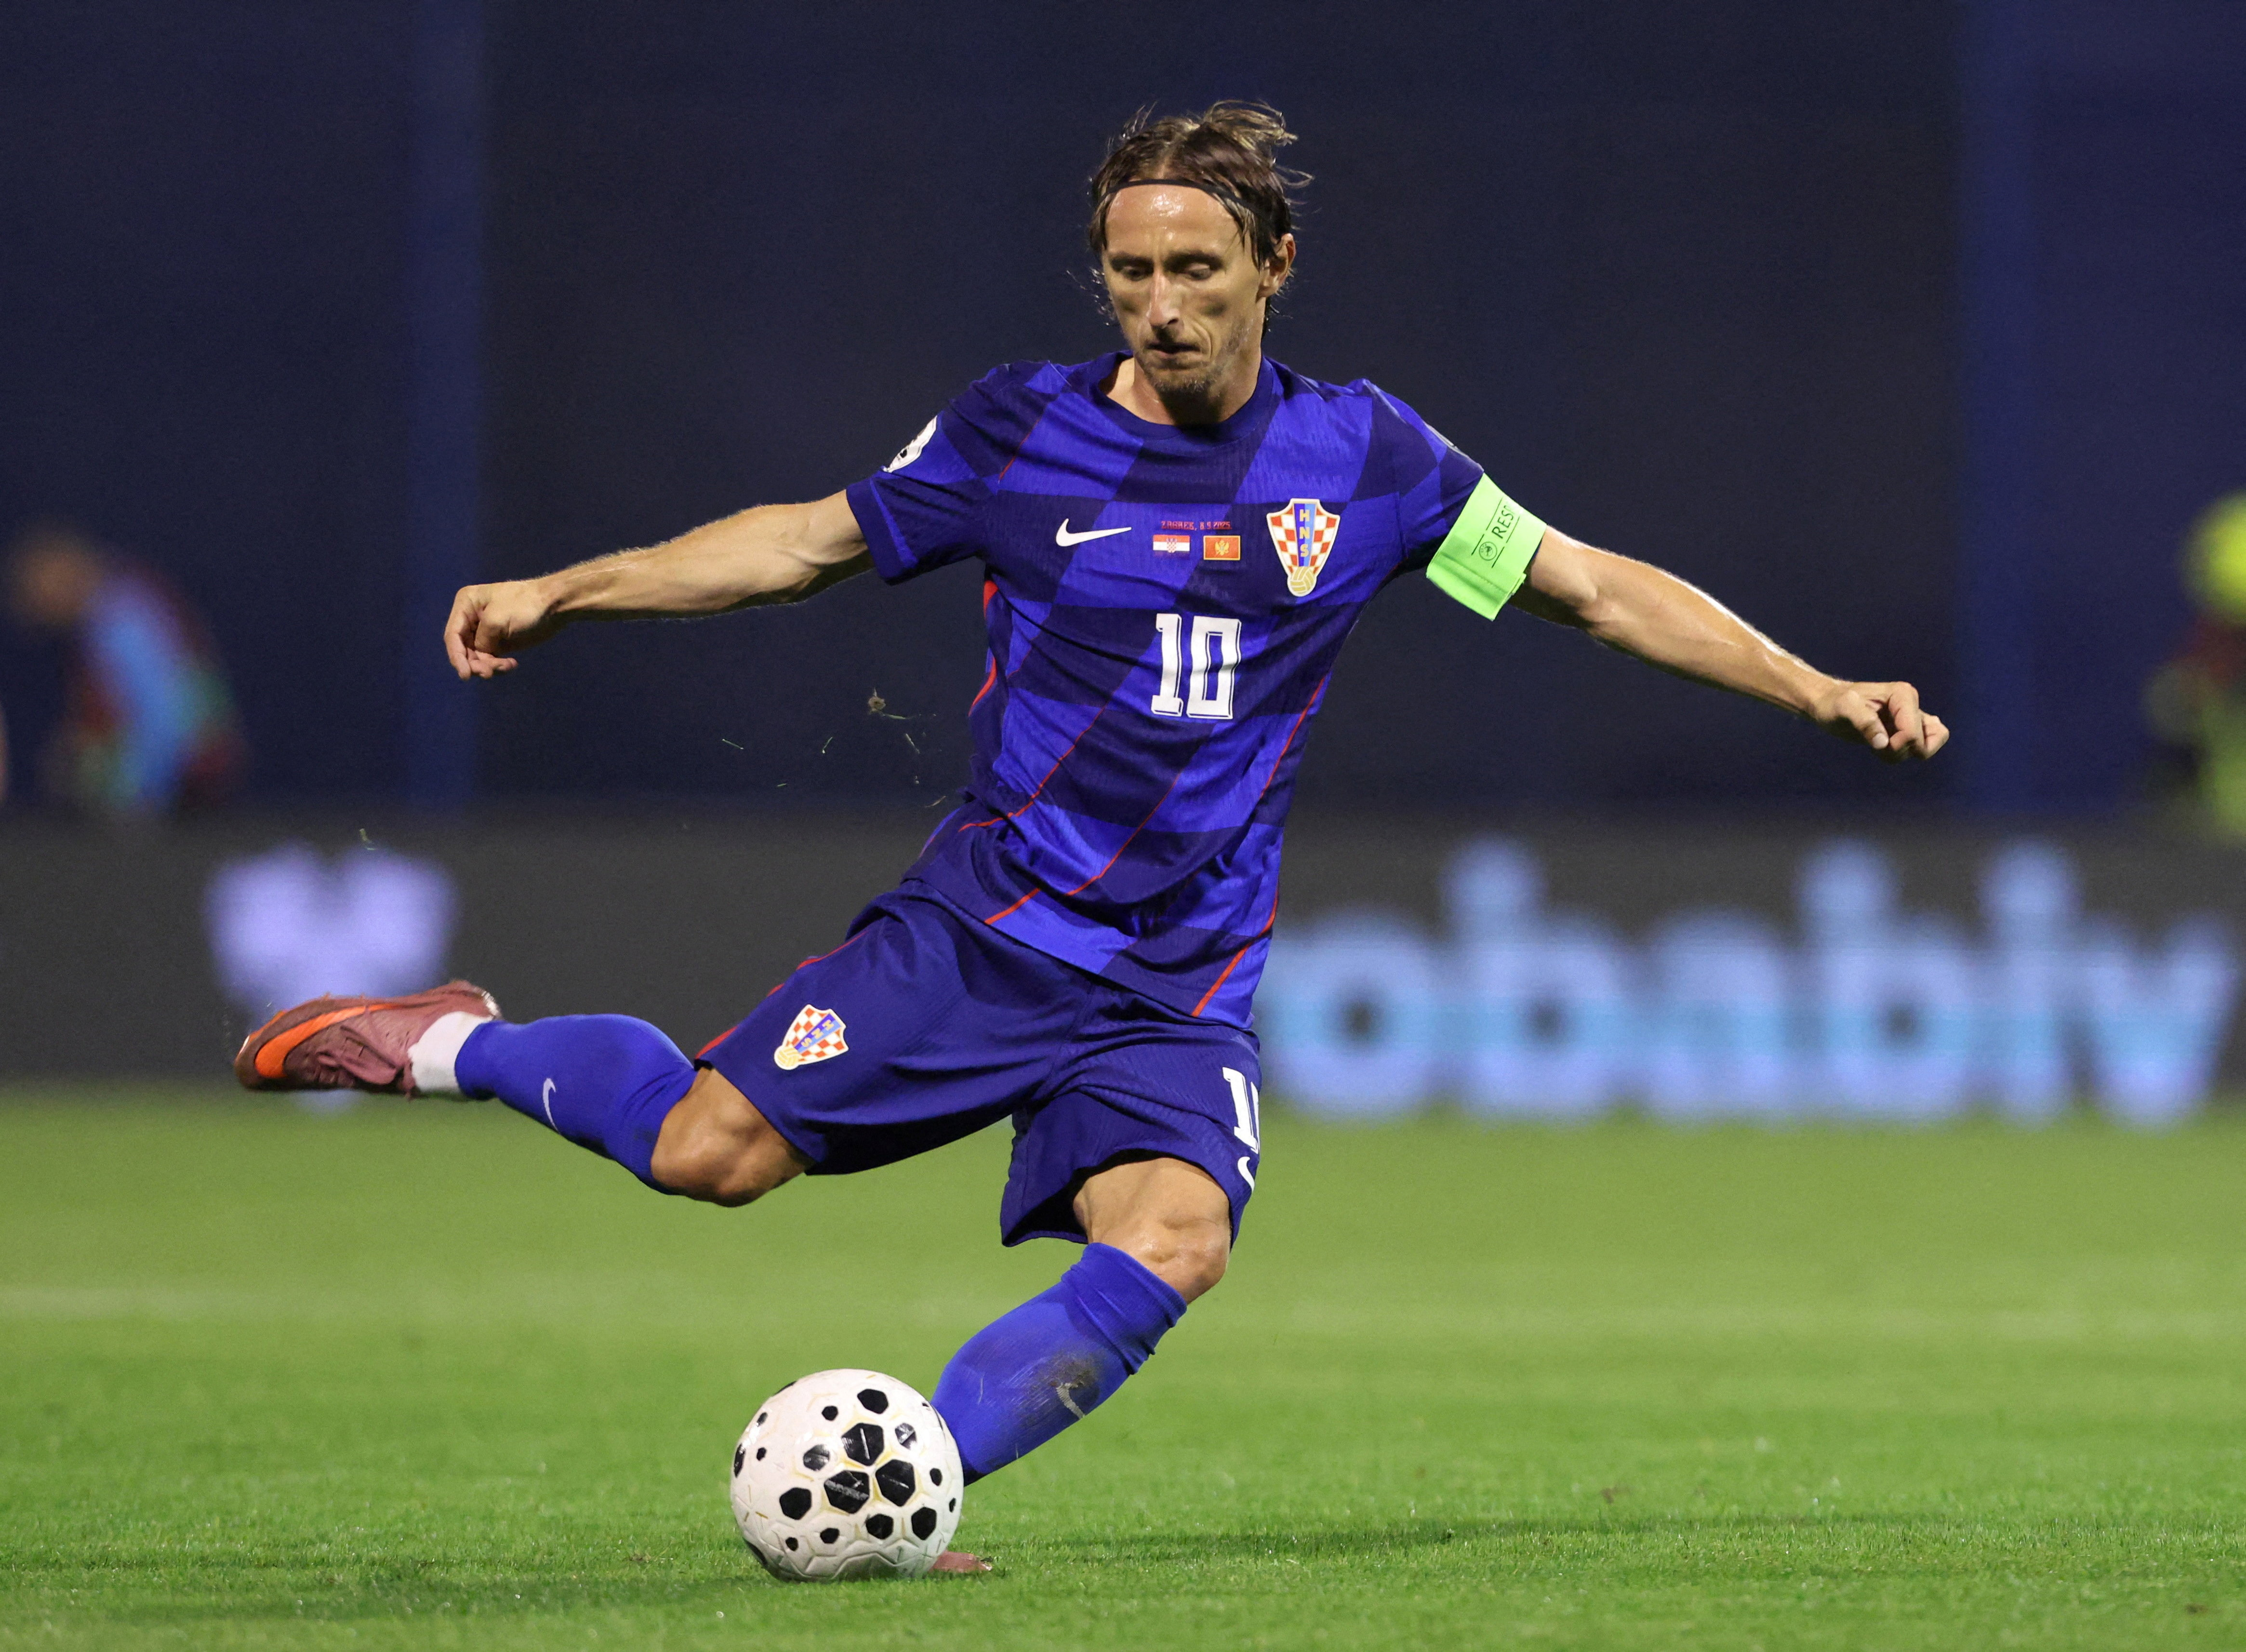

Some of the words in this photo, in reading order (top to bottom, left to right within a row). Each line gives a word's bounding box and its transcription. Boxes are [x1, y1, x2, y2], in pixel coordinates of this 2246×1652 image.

[1299, 509, 1310, 557] HNS
[1151, 613, 1242, 719] 10
[800, 1019, 835, 1047] HNS
